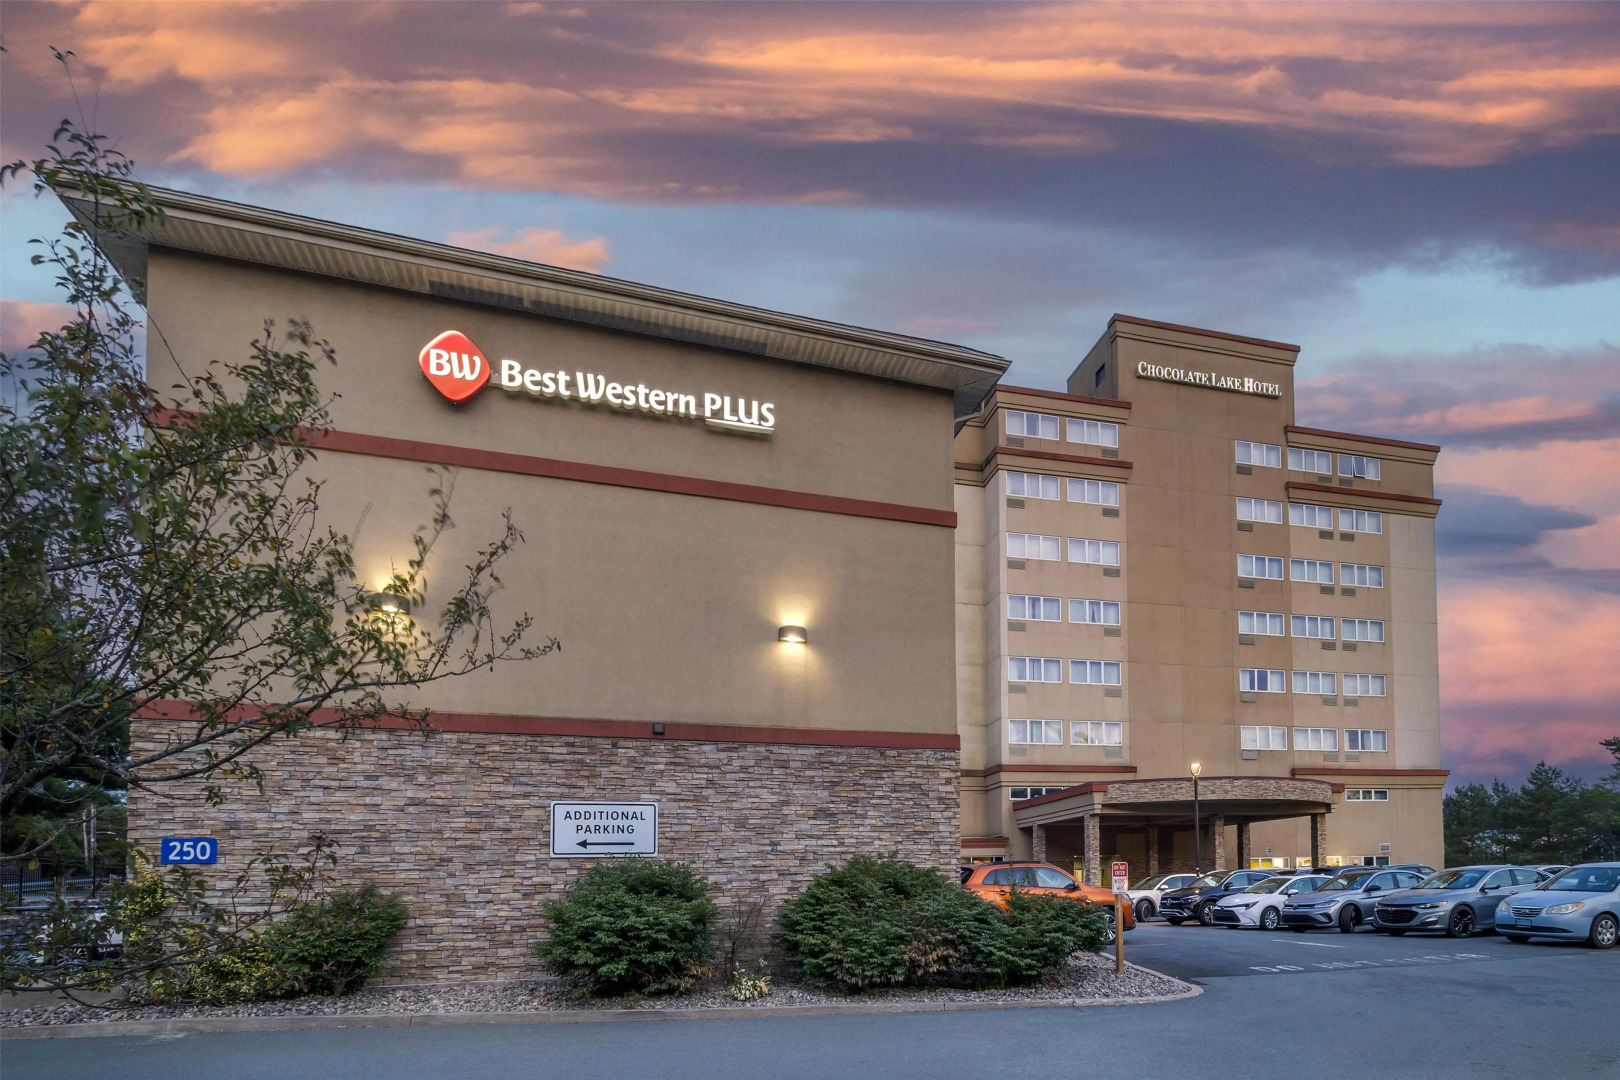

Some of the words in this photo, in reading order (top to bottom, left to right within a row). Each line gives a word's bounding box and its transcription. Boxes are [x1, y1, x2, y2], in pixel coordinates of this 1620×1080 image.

[429, 348, 481, 381] BW
[501, 359, 571, 396] Best
[575, 371, 697, 415] Western
[704, 392, 775, 428] PLUS
[1211, 372, 1242, 390] LAKE
[1244, 377, 1282, 396] HOTEL
[564, 810, 646, 821] ADDITIONAL
[576, 824, 635, 835] PARKING
[168, 841, 211, 860] 250
